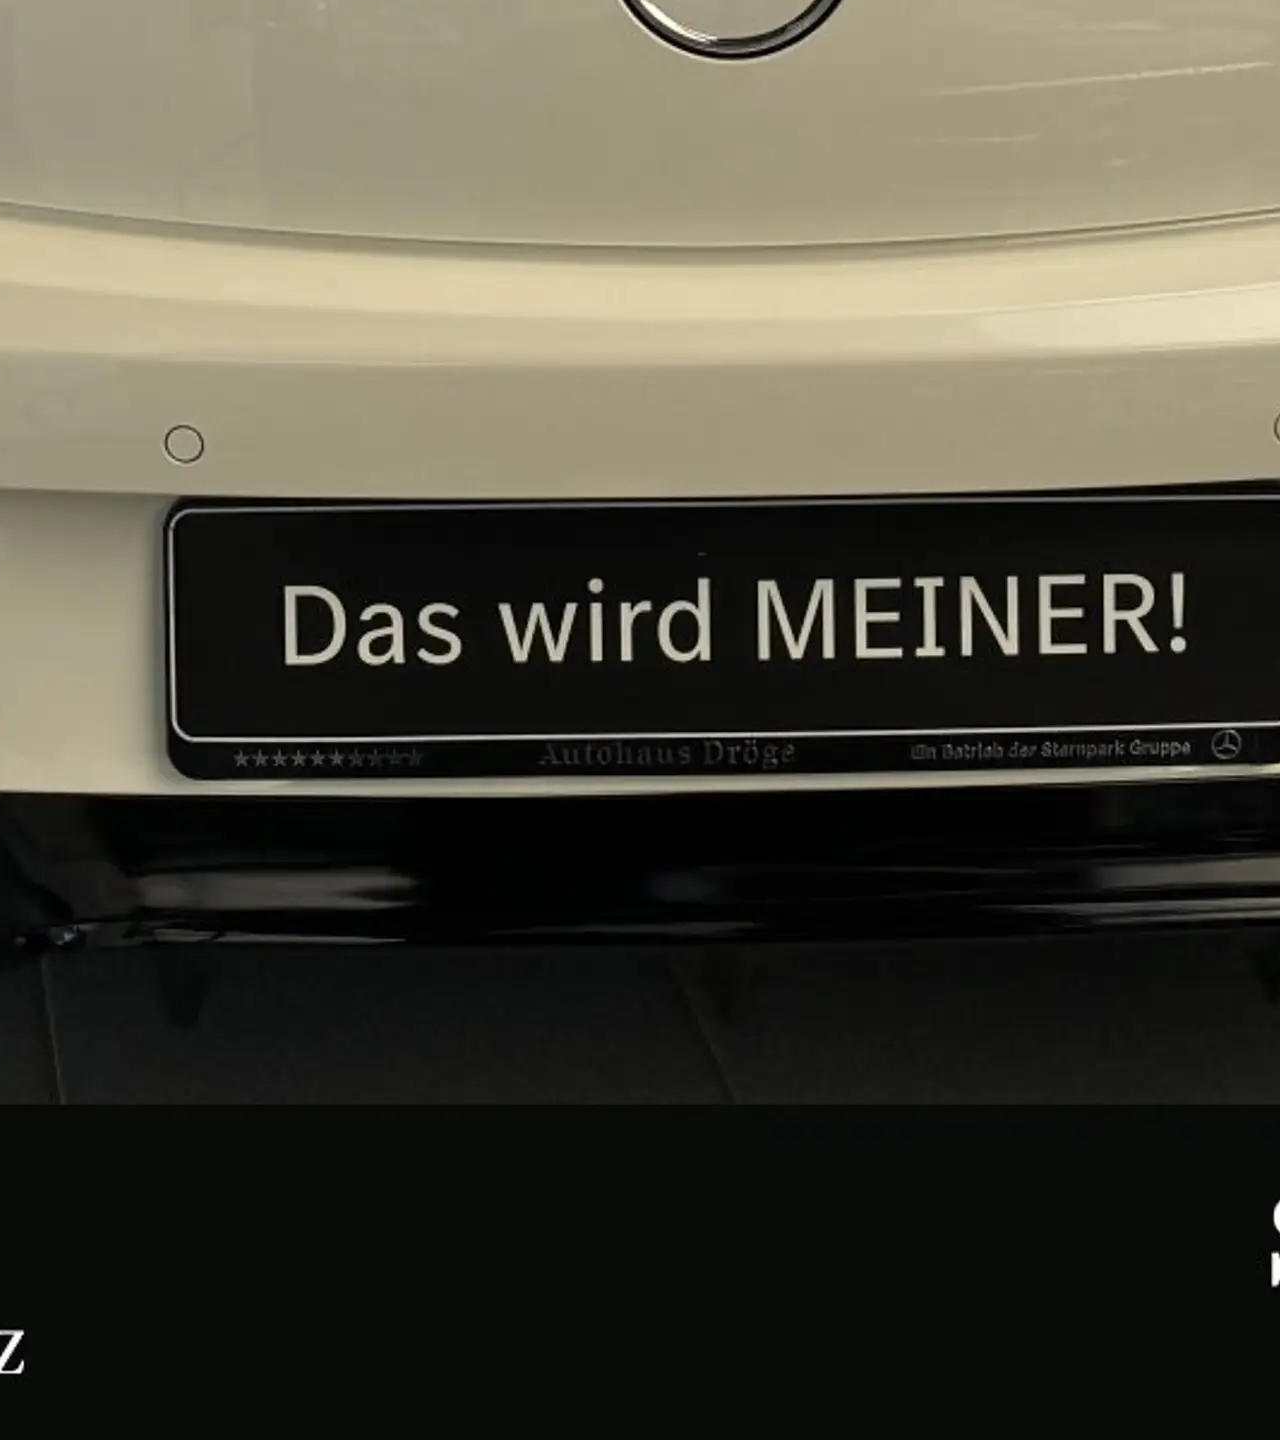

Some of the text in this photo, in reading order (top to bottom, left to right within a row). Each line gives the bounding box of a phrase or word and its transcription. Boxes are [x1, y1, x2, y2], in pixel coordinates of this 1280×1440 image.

[285, 572, 1187, 666] Das wird MEINER!
[538, 738, 797, 770] Autohaus Dröge
[1009, 740, 1038, 758] der
[1041, 739, 1125, 760] Sternpark
[1129, 738, 1192, 758] Gruppe
